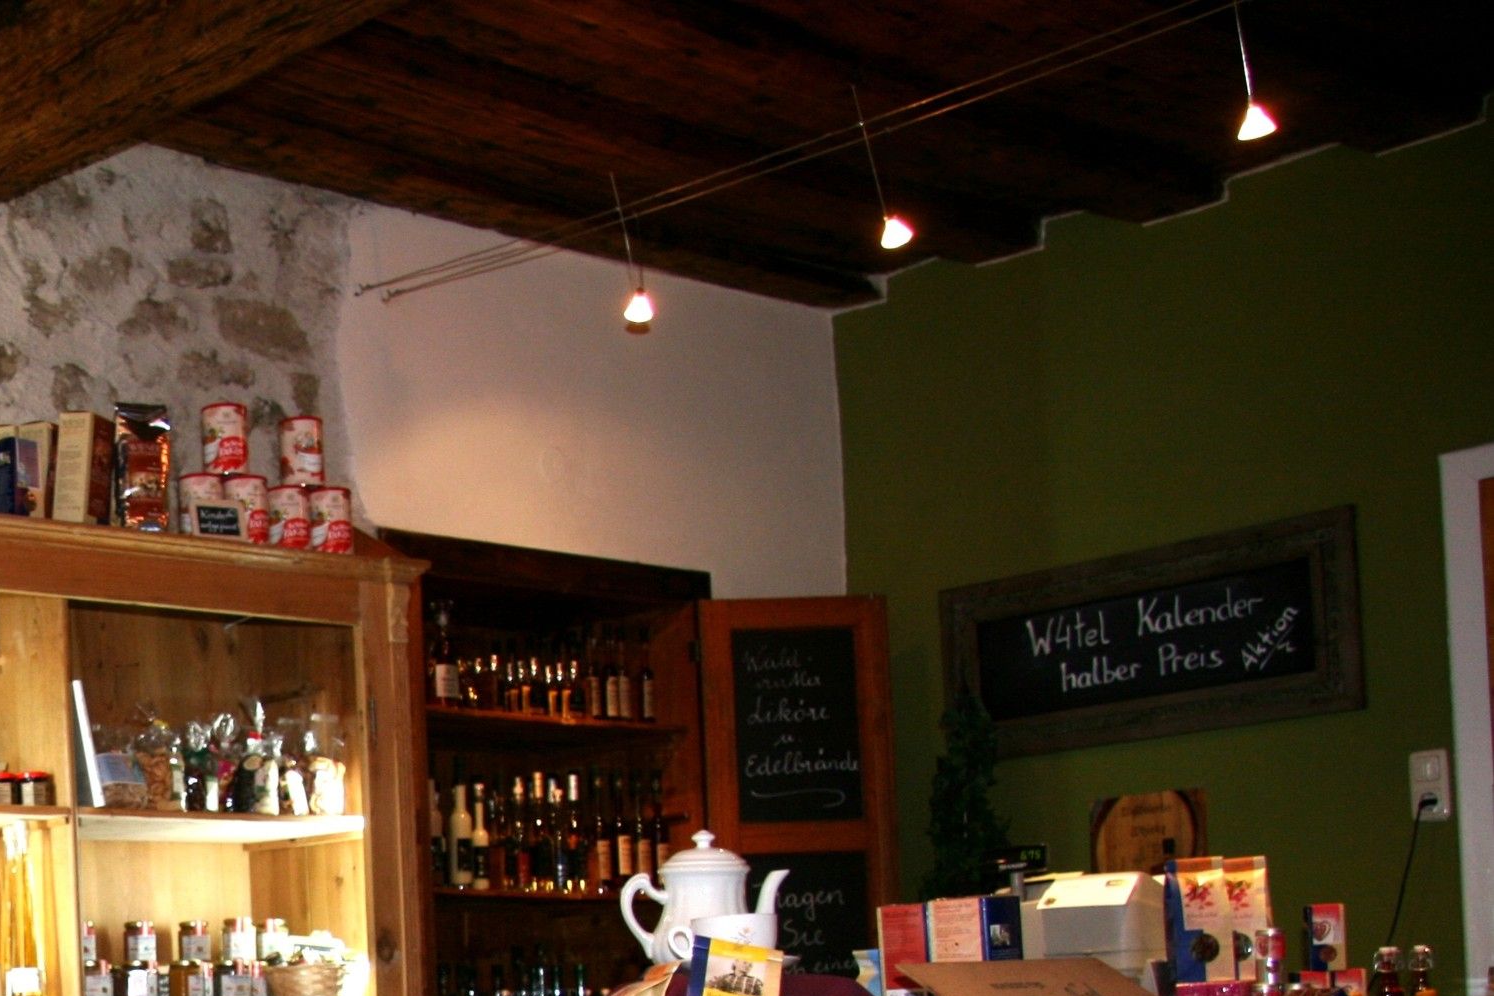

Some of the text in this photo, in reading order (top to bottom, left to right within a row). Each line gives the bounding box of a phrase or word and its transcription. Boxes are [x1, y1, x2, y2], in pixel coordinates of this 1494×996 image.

[1025, 586, 1264, 657] W4tel Kalender
[1241, 604, 1300, 670] Aktion
[1060, 642, 1225, 693] halber Preis
[745, 747, 860, 778] Edelbrände
[783, 918, 826, 949] Sie
